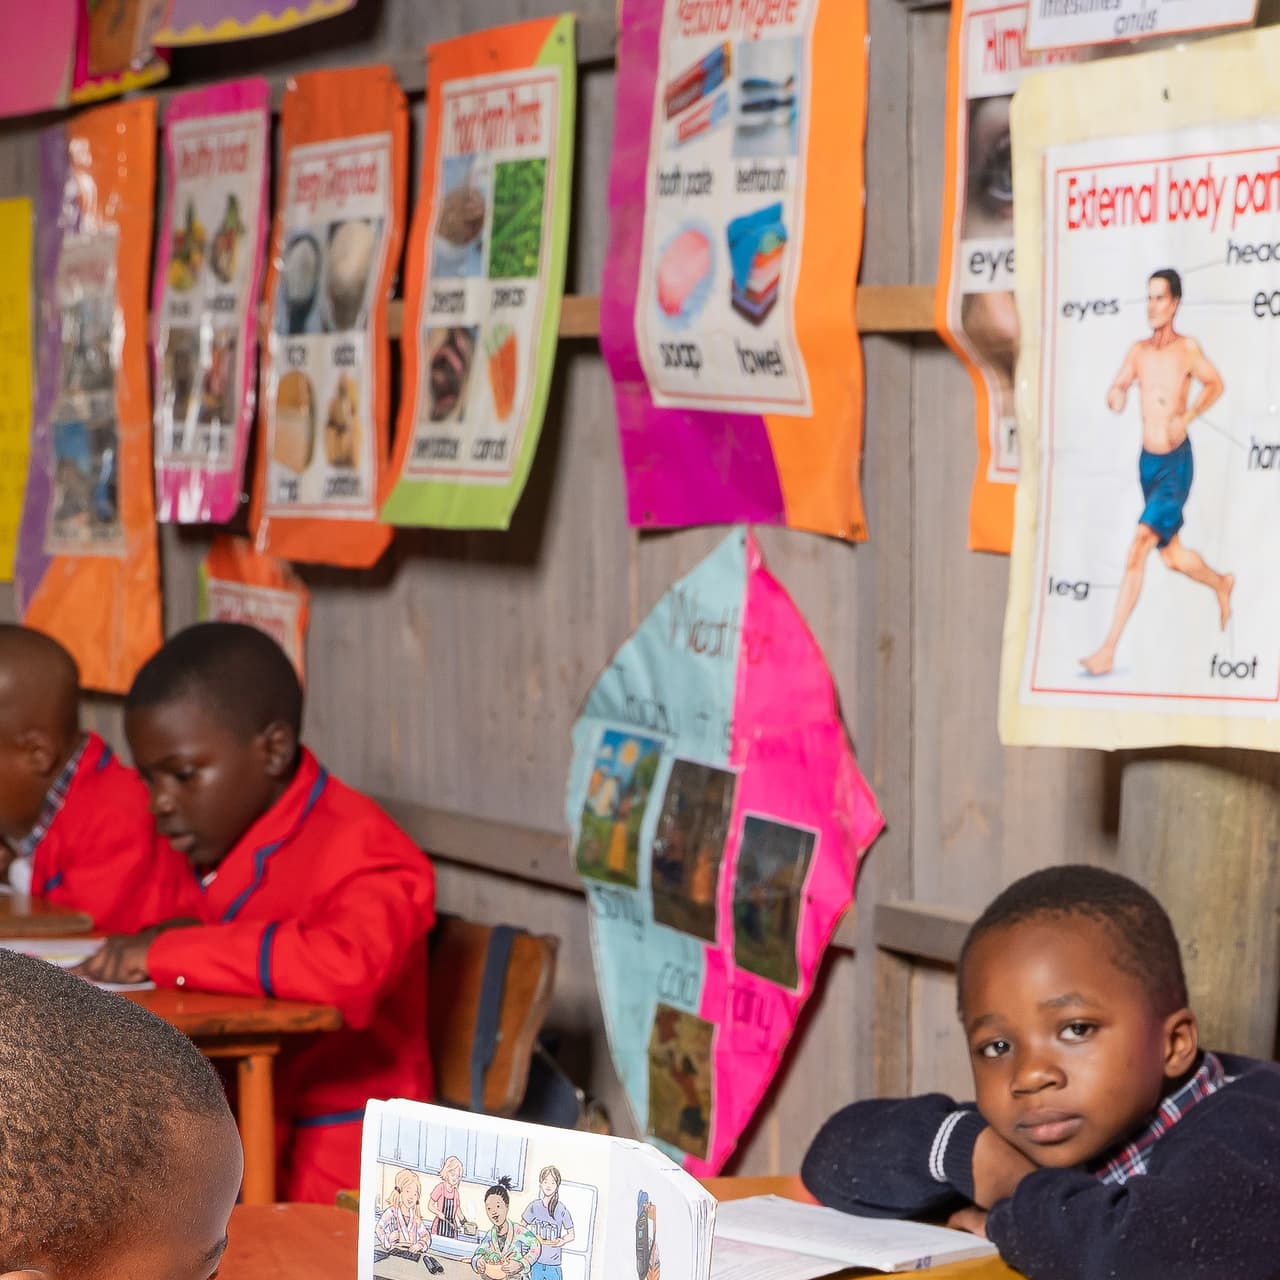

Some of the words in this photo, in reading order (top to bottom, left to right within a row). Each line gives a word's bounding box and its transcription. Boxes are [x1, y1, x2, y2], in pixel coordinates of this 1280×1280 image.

[1113, 9, 1157, 35] anus
[1067, 166, 1159, 231] External
[1167, 160, 1226, 233] body
[1062, 297, 1120, 322] eyes
[734, 337, 787, 377] towel
[1047, 575, 1091, 601] leg
[1210, 653, 1260, 681] foot
